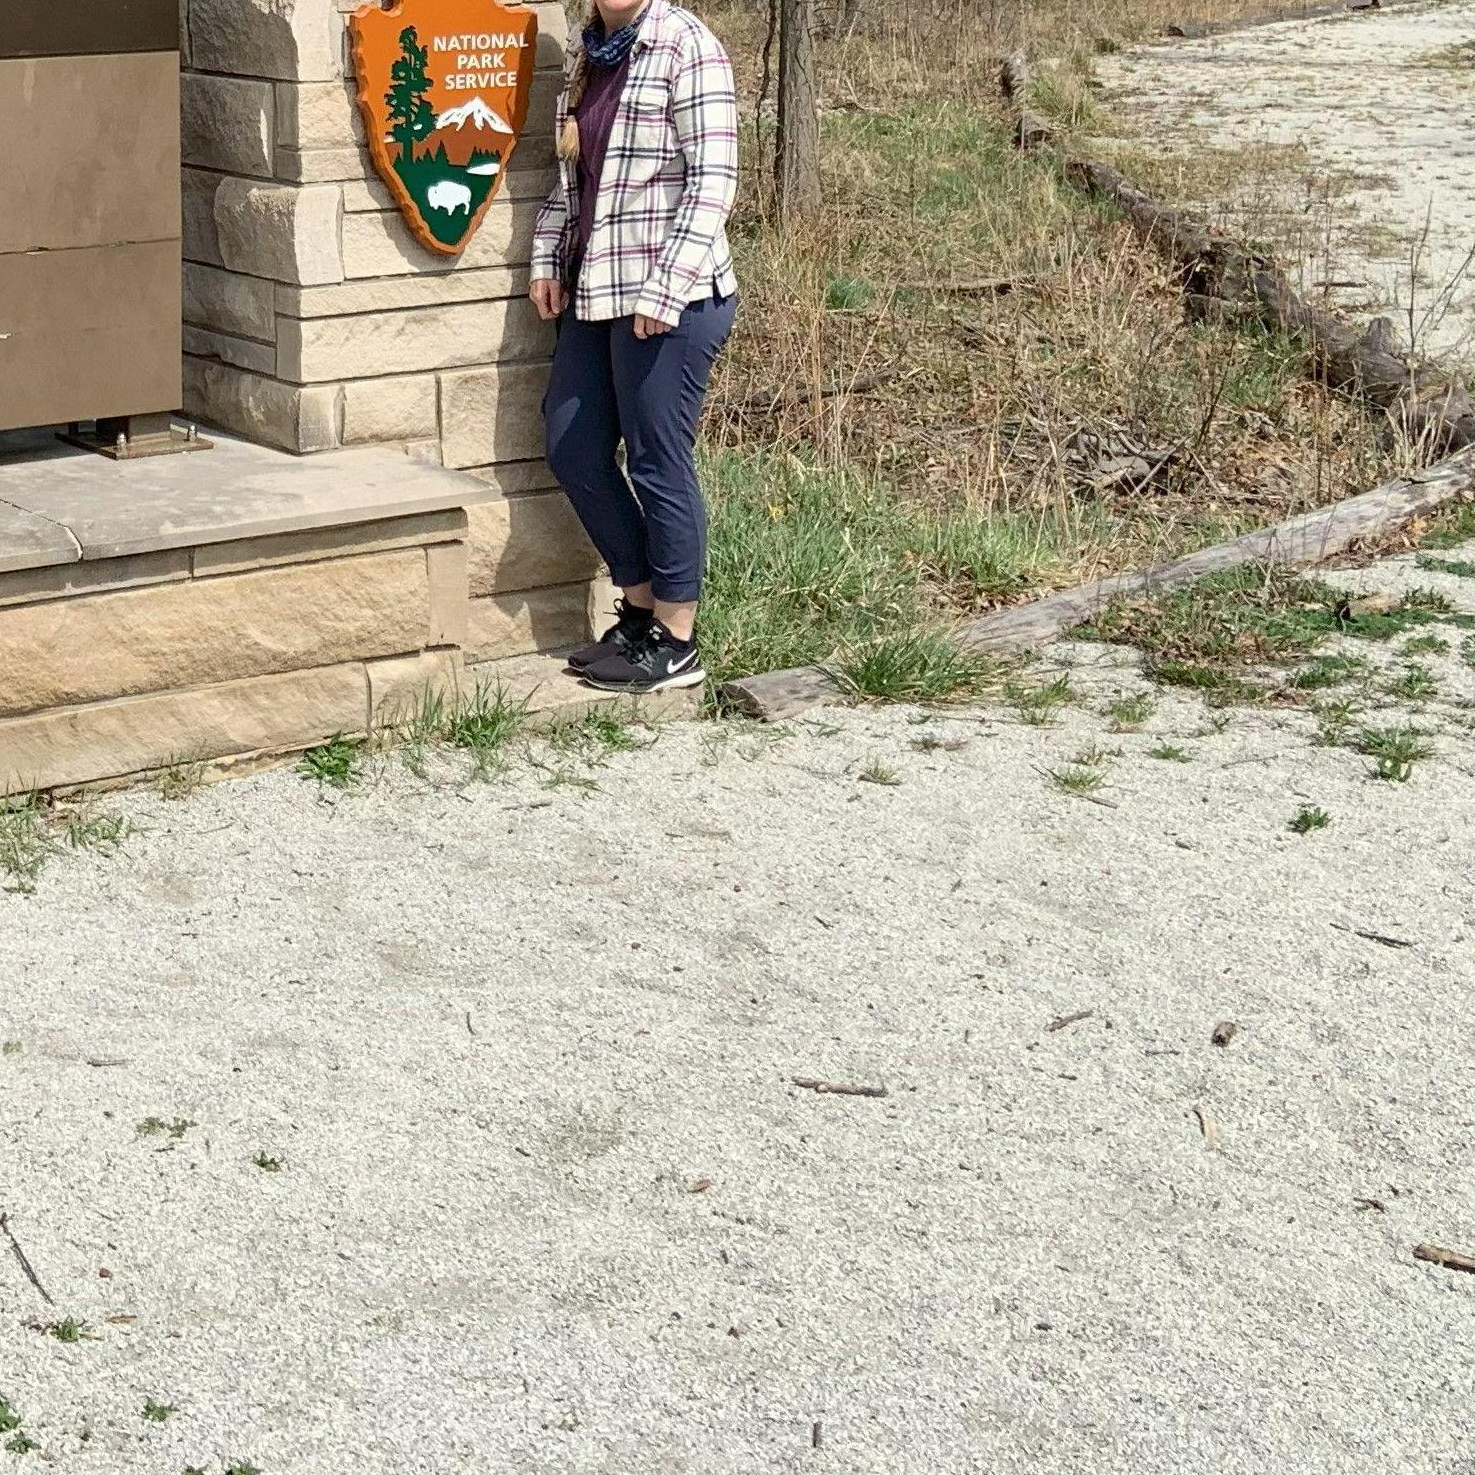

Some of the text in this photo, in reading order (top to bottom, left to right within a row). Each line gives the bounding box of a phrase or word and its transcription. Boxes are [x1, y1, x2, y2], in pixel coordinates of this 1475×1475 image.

[433, 32, 529, 52] NATIONAL
[456, 53, 506, 70] PARK
[444, 71, 517, 90] SERVICE
